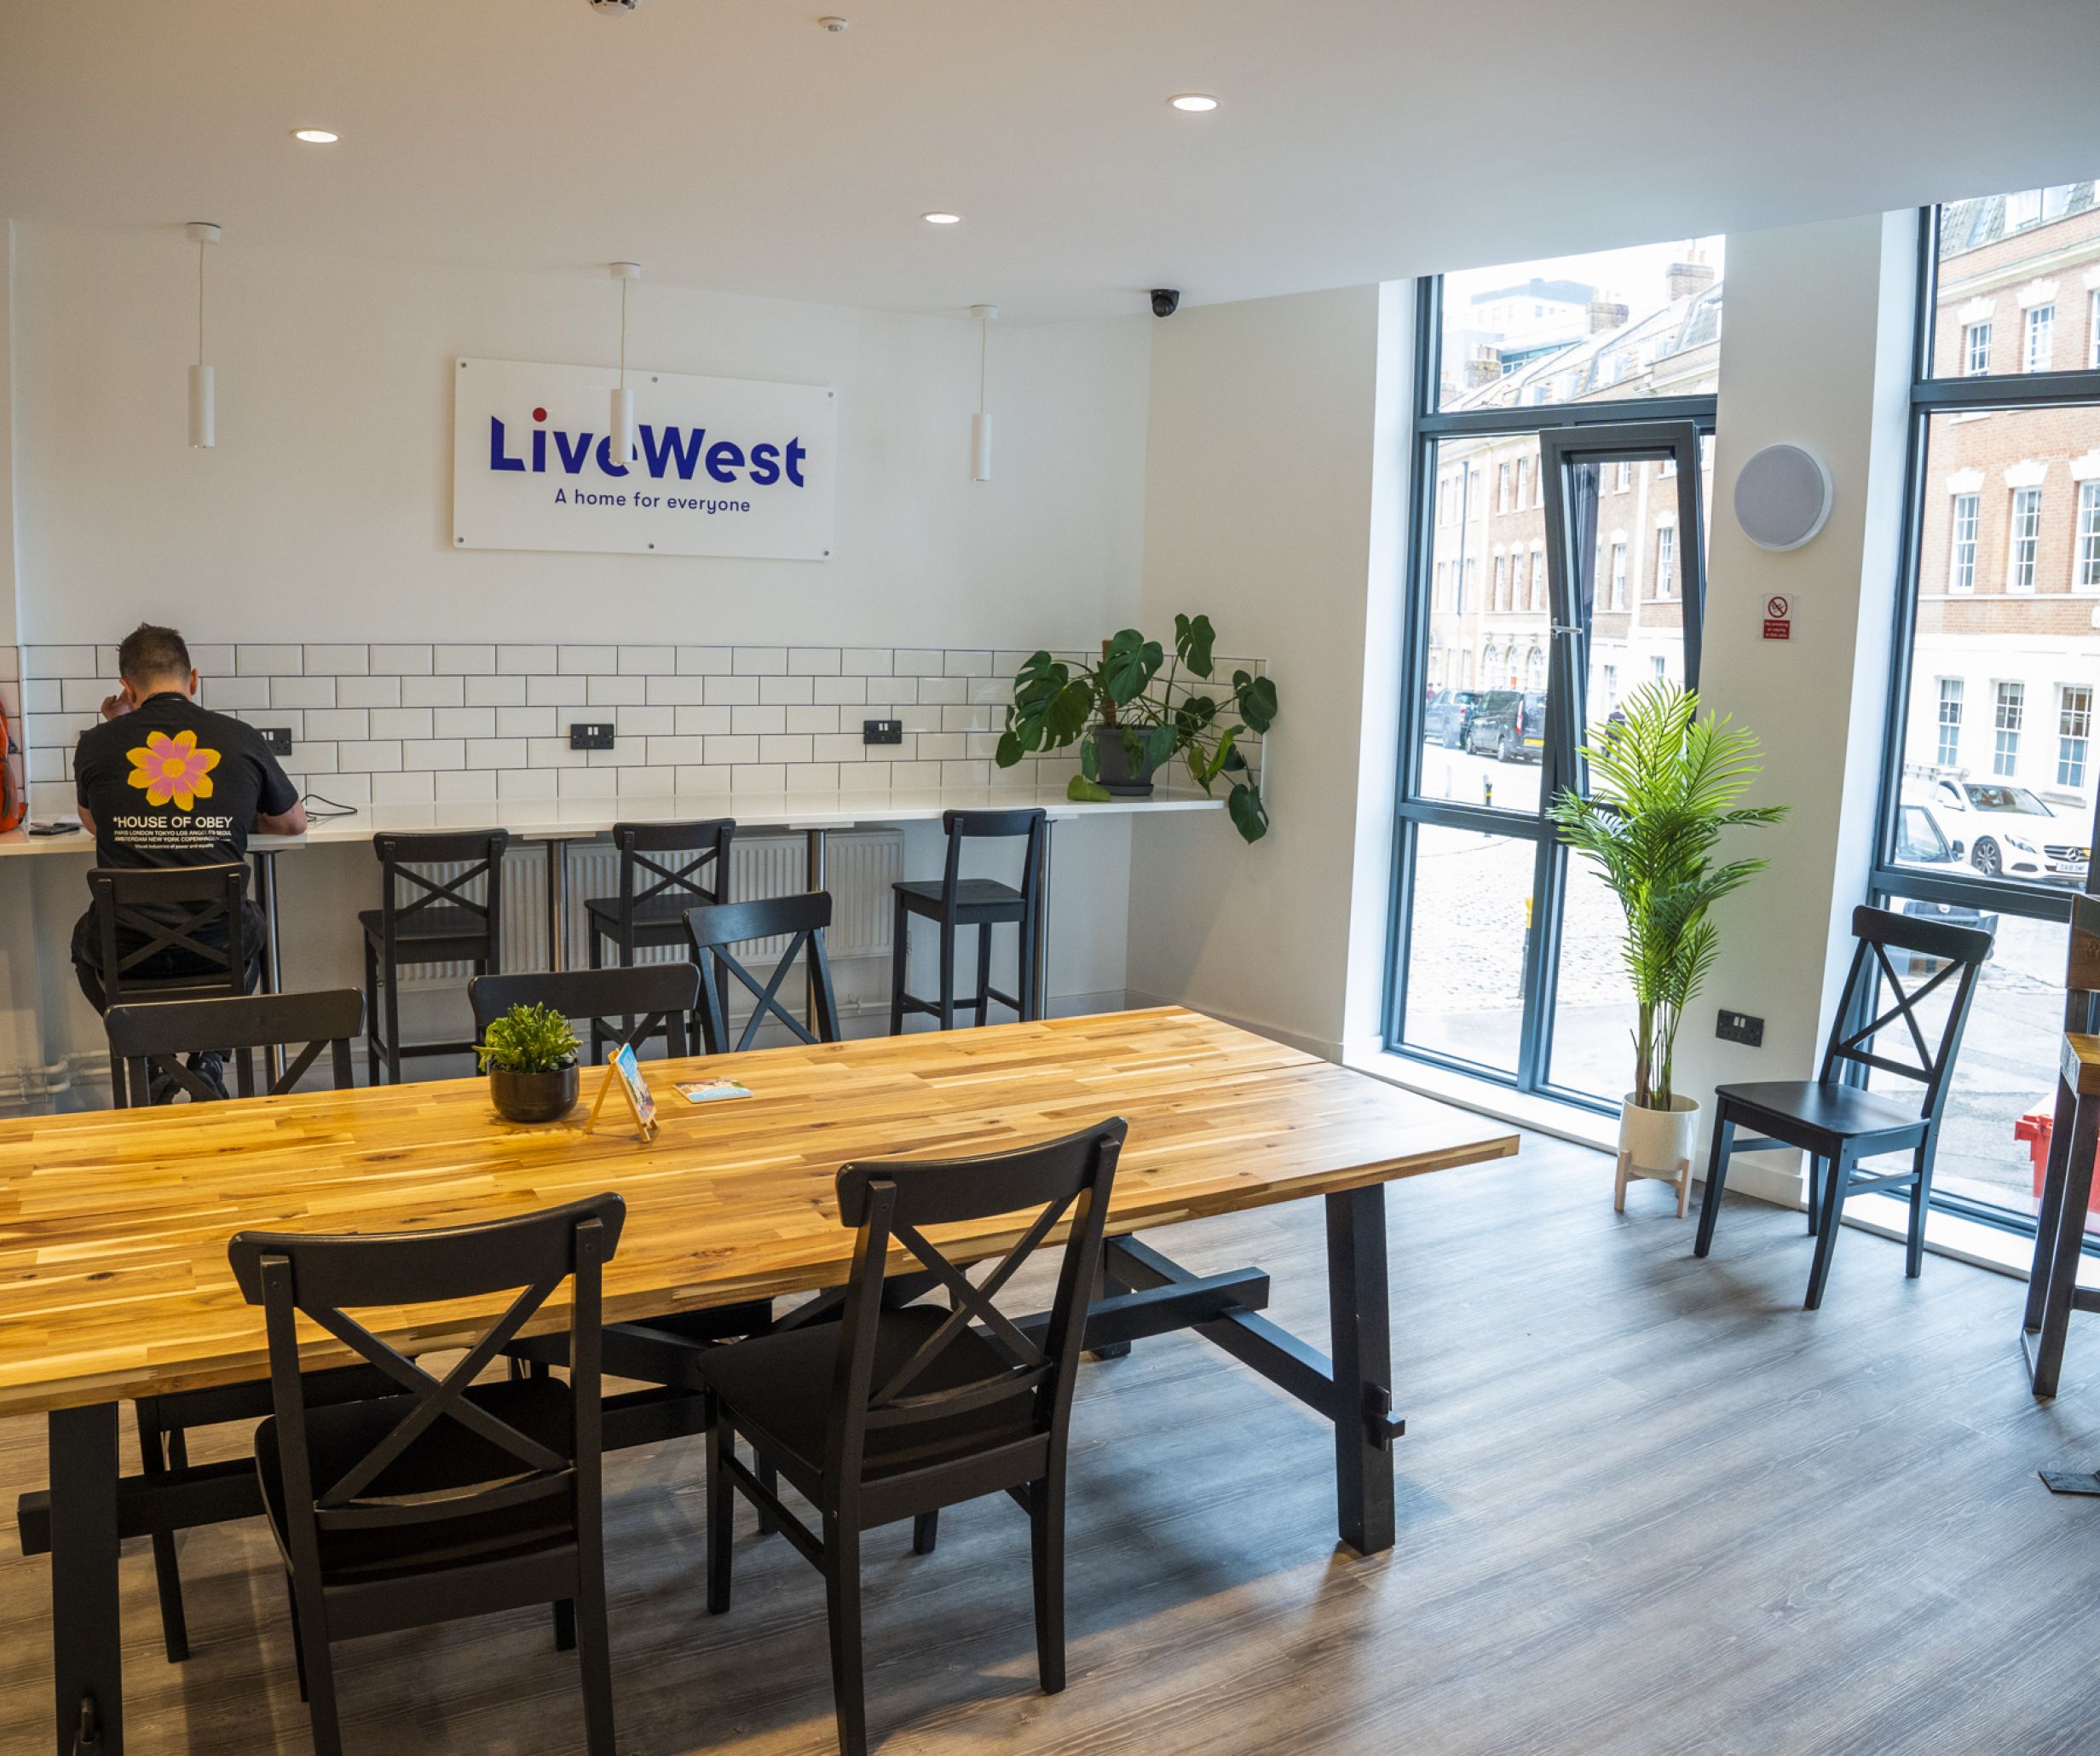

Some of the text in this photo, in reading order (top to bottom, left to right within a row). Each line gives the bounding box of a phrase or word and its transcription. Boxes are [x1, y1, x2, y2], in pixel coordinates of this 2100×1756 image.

[555, 488, 750, 515] A home for everyone
[171, 816, 192, 829] OF
[195, 816, 234, 829] OBEY
